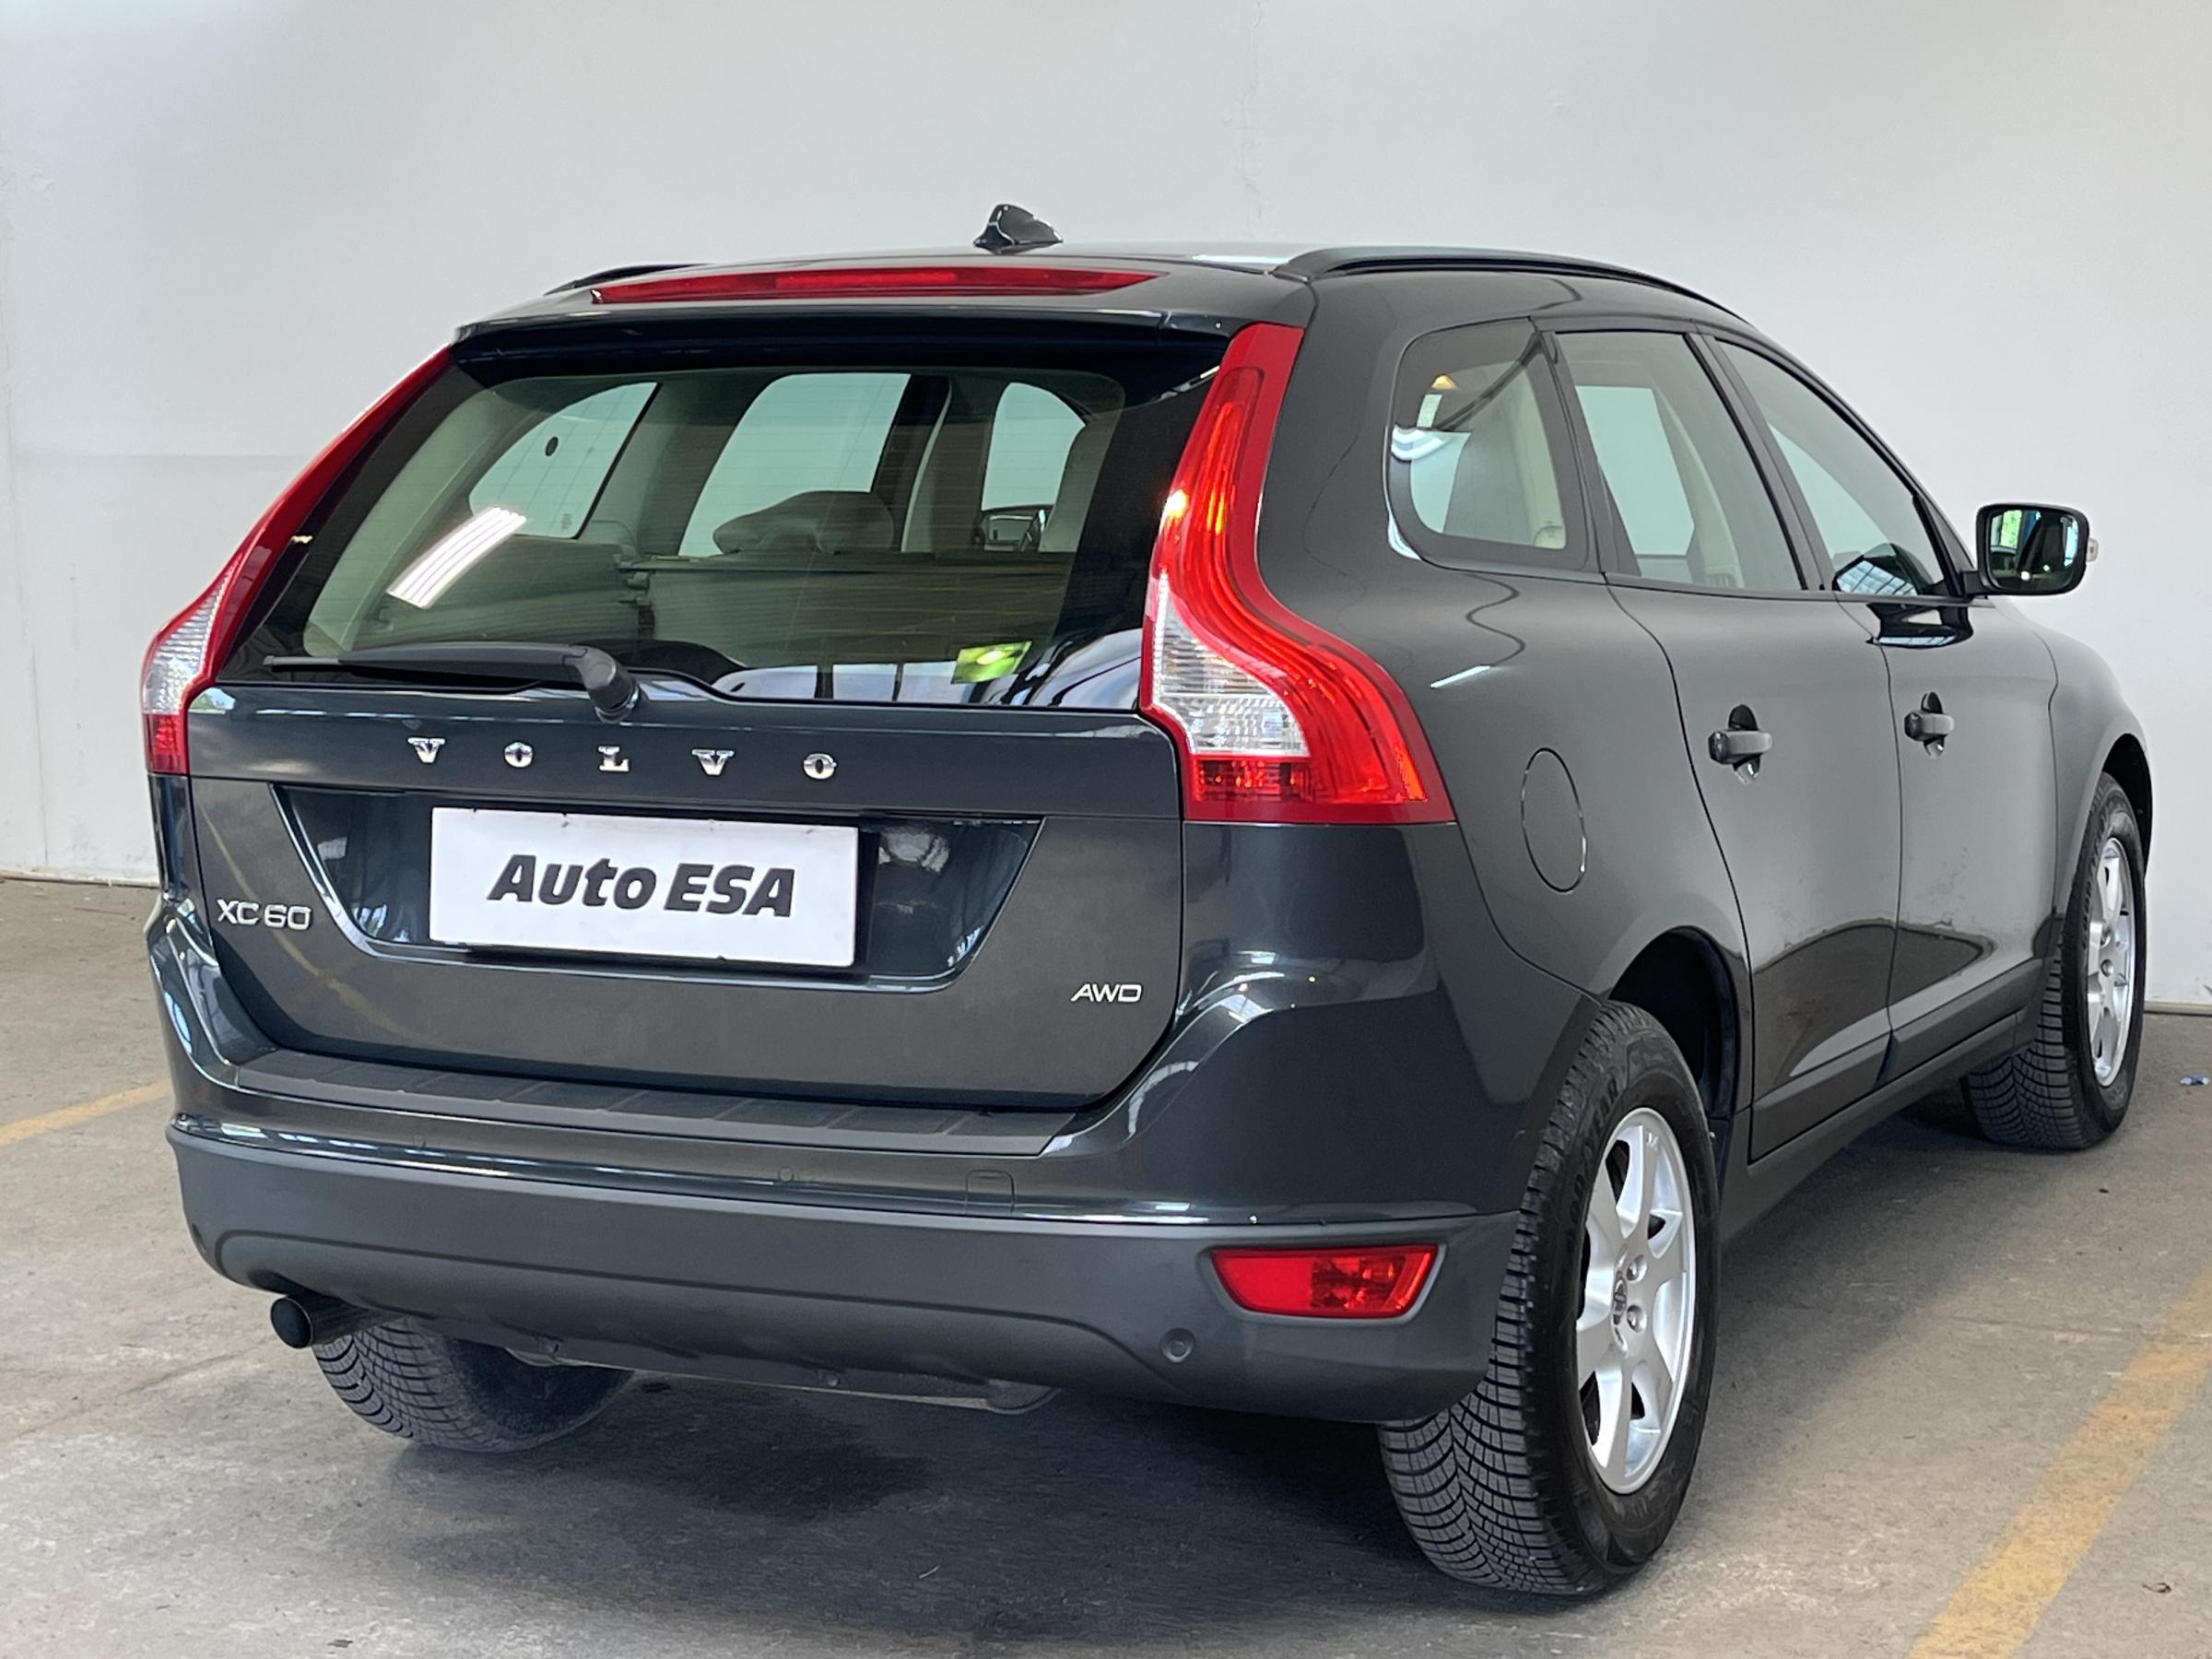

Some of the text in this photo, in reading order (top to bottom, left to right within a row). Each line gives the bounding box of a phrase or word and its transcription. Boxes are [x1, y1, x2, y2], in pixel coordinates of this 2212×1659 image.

[407, 736, 837, 781] VOLVO
[486, 853, 795, 918] Auto ESA
[1070, 982, 1143, 1003] AWD
